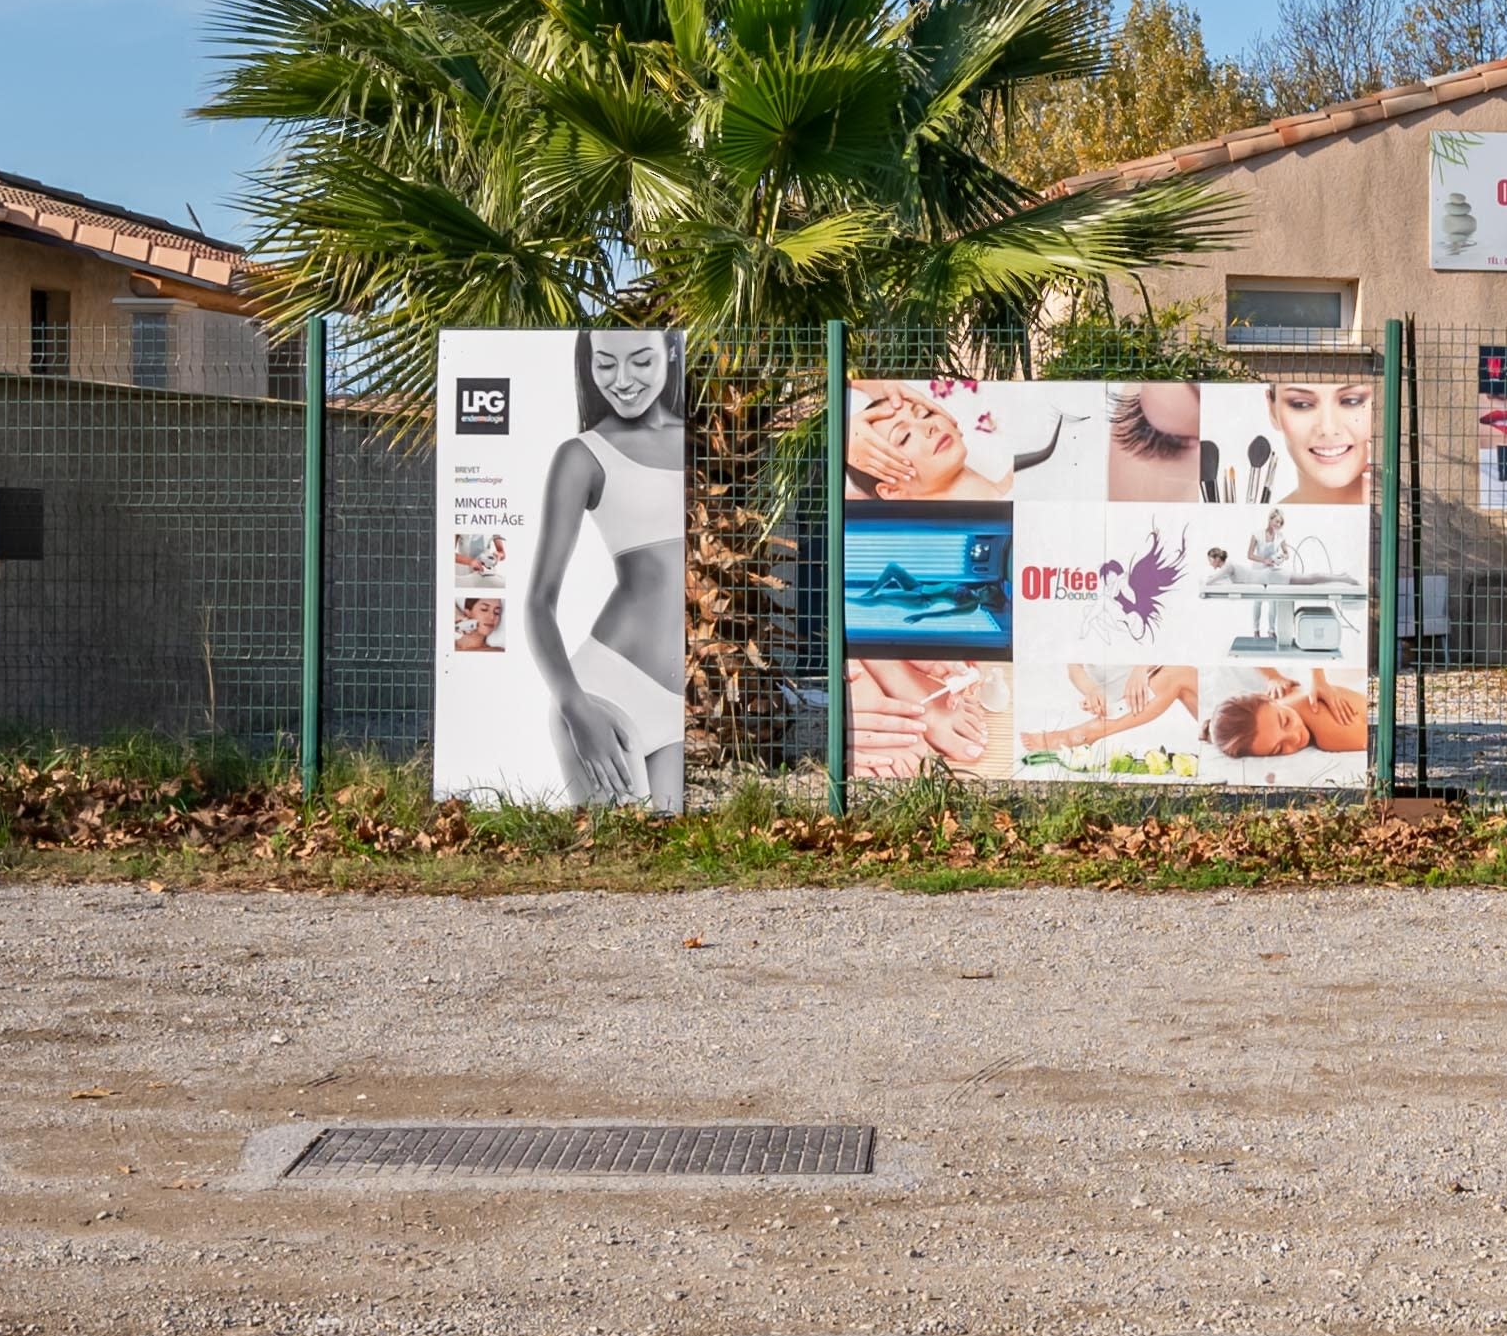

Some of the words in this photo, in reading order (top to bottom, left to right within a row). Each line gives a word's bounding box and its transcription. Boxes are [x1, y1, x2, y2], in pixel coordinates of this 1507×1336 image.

[462, 391, 505, 413] LPG
[455, 466, 480, 474] BREVET
[455, 497, 508, 509] MINCEUR
[455, 514, 468, 525] ET
[471, 512, 524, 526] ANTI-ÂGE
